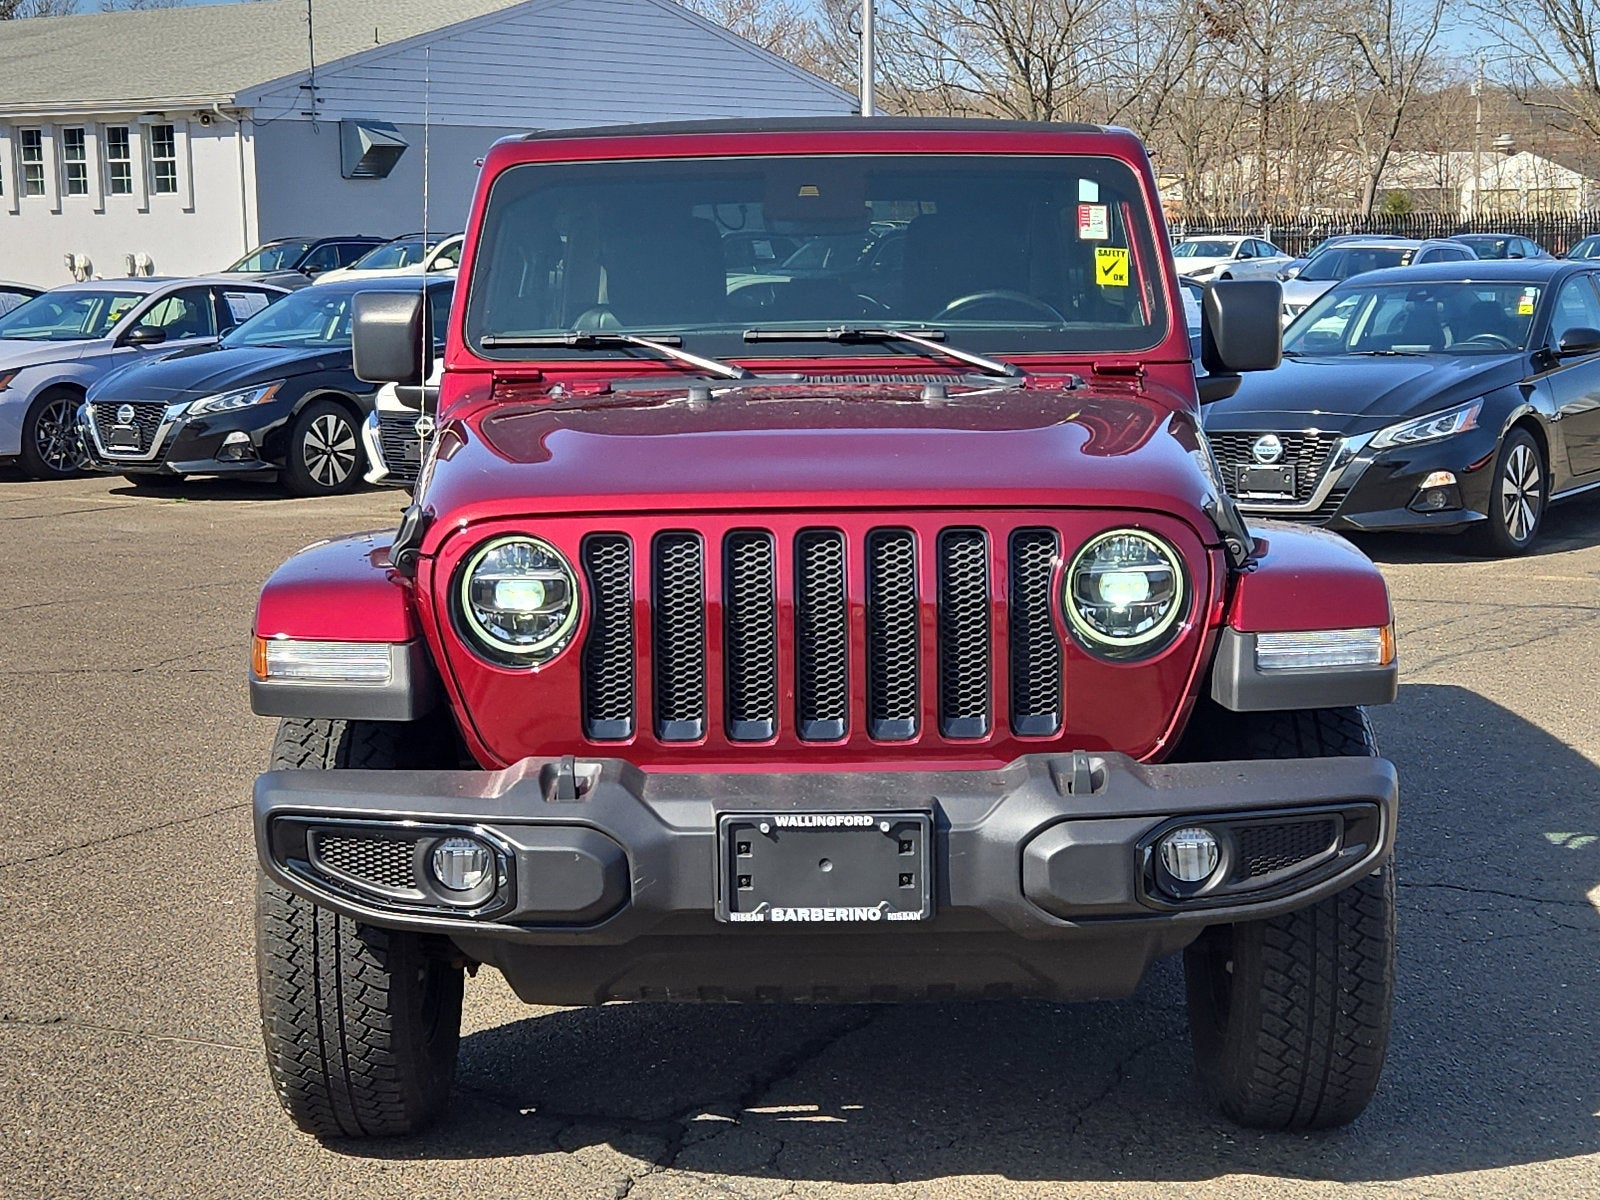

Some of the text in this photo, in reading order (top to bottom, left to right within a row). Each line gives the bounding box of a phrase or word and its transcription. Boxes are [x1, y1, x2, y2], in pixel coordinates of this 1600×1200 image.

[1097, 249, 1126, 258] SAFETY
[1113, 273, 1125, 281] OK
[774, 815, 874, 827] WALLINGFORD
[771, 907, 882, 922] BARBERINO
